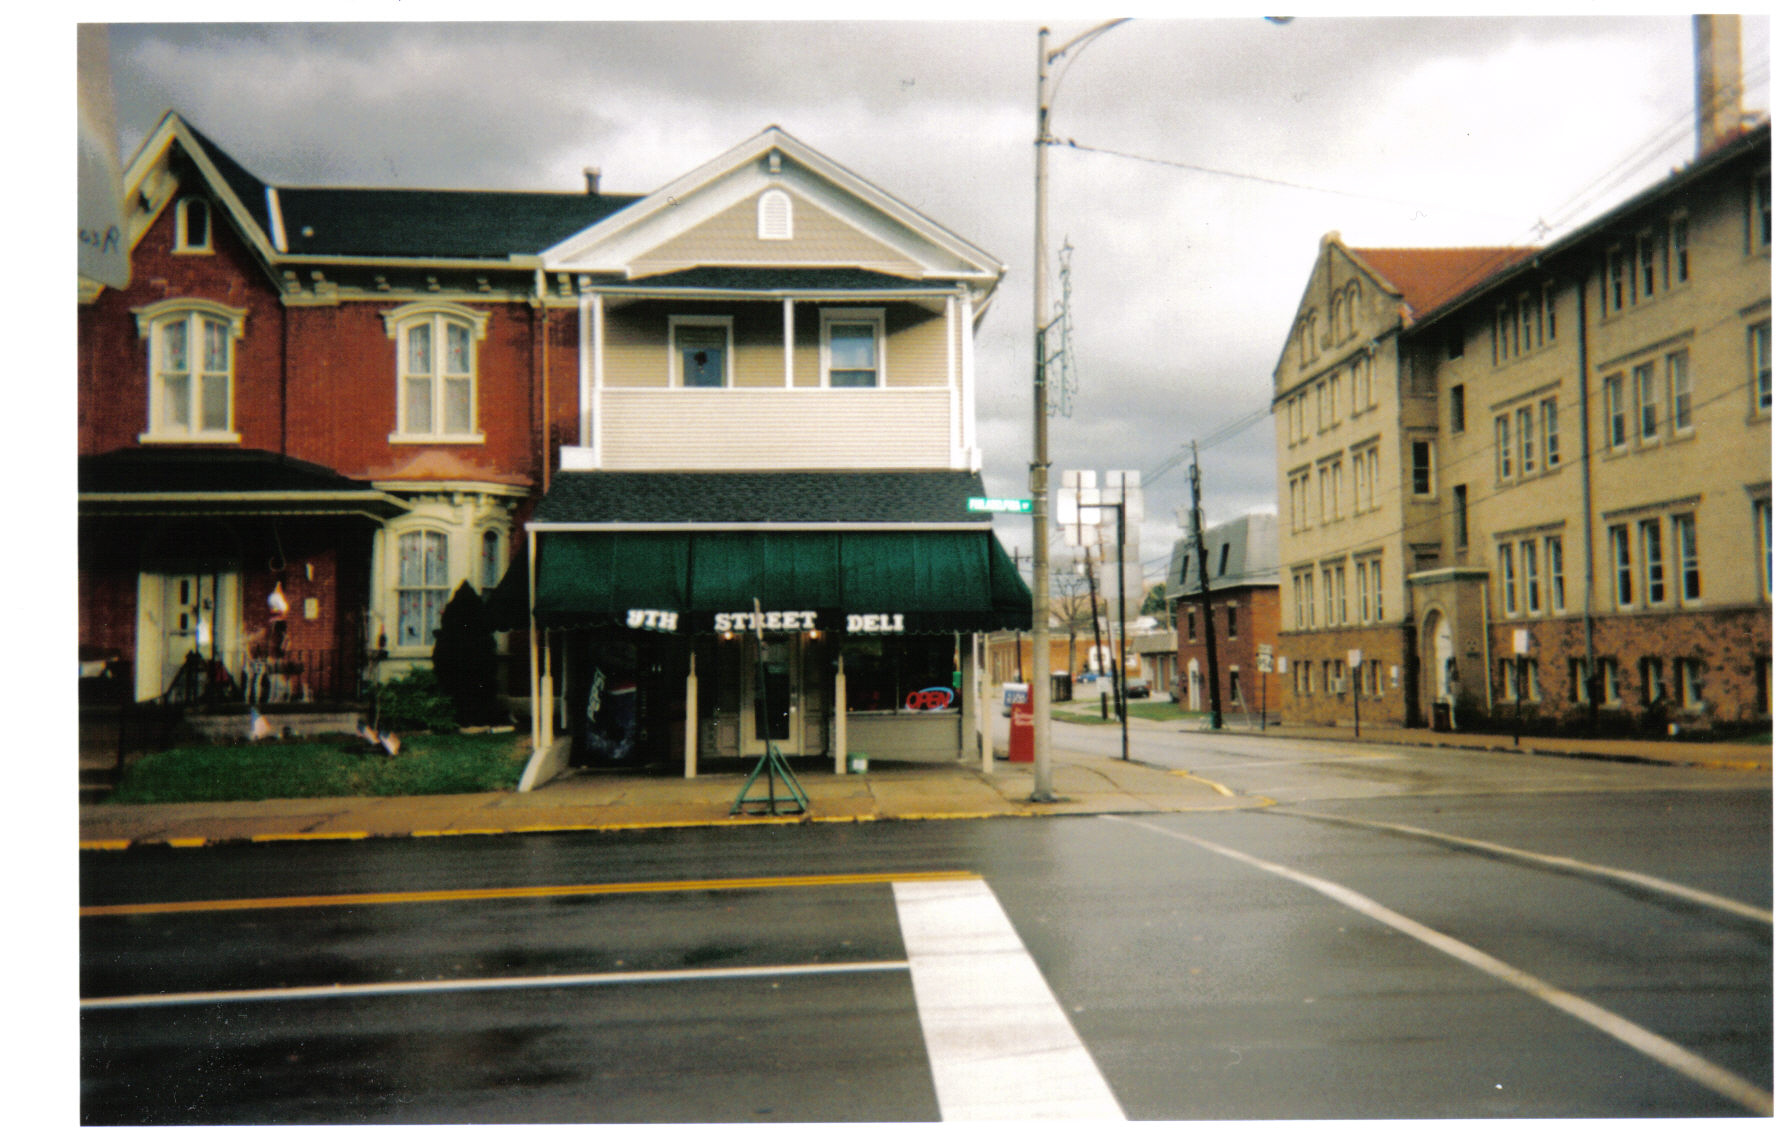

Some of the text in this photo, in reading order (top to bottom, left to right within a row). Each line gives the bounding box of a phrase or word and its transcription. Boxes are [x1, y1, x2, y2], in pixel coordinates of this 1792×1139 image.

[714, 611, 817, 631] STREET
[847, 613, 905, 632] DELI
[906, 691, 952, 709] OPEN
